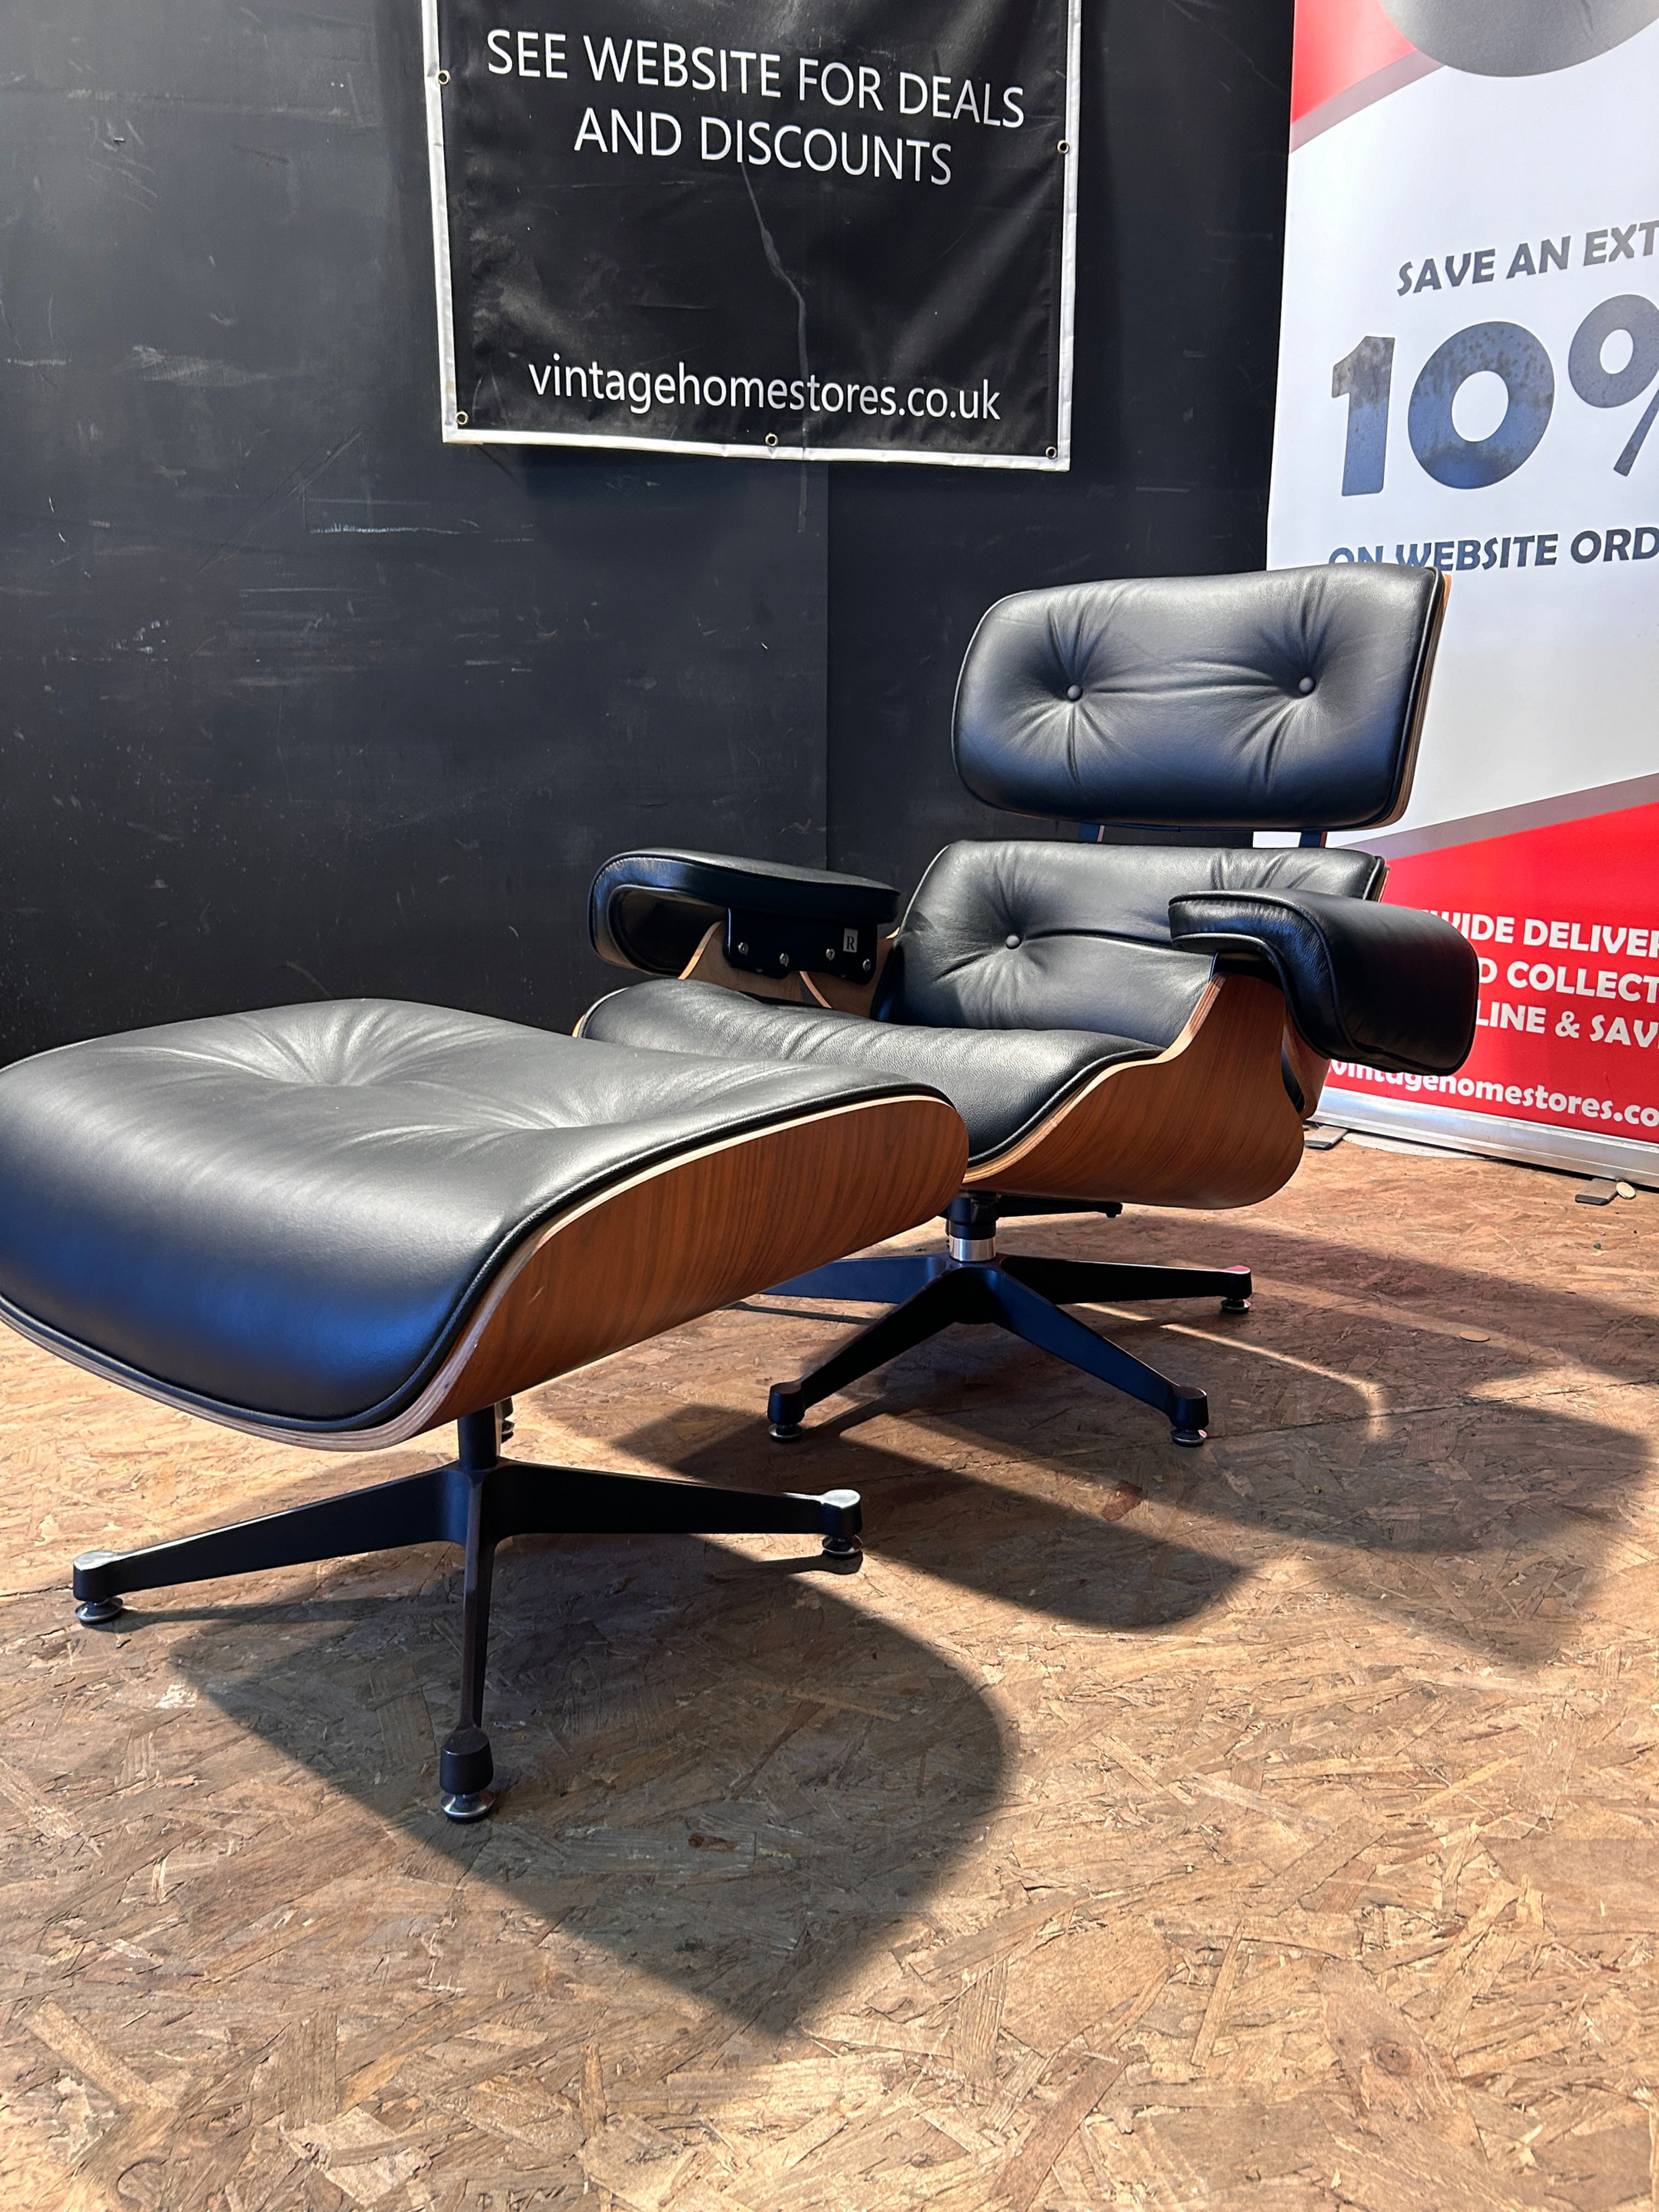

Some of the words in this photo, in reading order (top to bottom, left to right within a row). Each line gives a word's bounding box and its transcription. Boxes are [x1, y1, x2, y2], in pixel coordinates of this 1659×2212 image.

[487, 30, 568, 80] SEE
[583, 35, 782, 99] WEBSITE
[798, 59, 885, 111] FOR
[899, 73, 1025, 129] DEALS
[574, 108, 682, 157] AND
[700, 116, 952, 187] DISCOUNTS
[1397, 249, 1496, 296] SAVE
[1505, 235, 1571, 279] AN
[528, 353, 1002, 421] vintagehomestores.co.uk
[1396, 533, 1559, 572] WEBSITE
[847, 935, 855, 950] R
[1555, 1011, 1581, 1039] &
[1589, 1014, 1659, 1049] SAV
